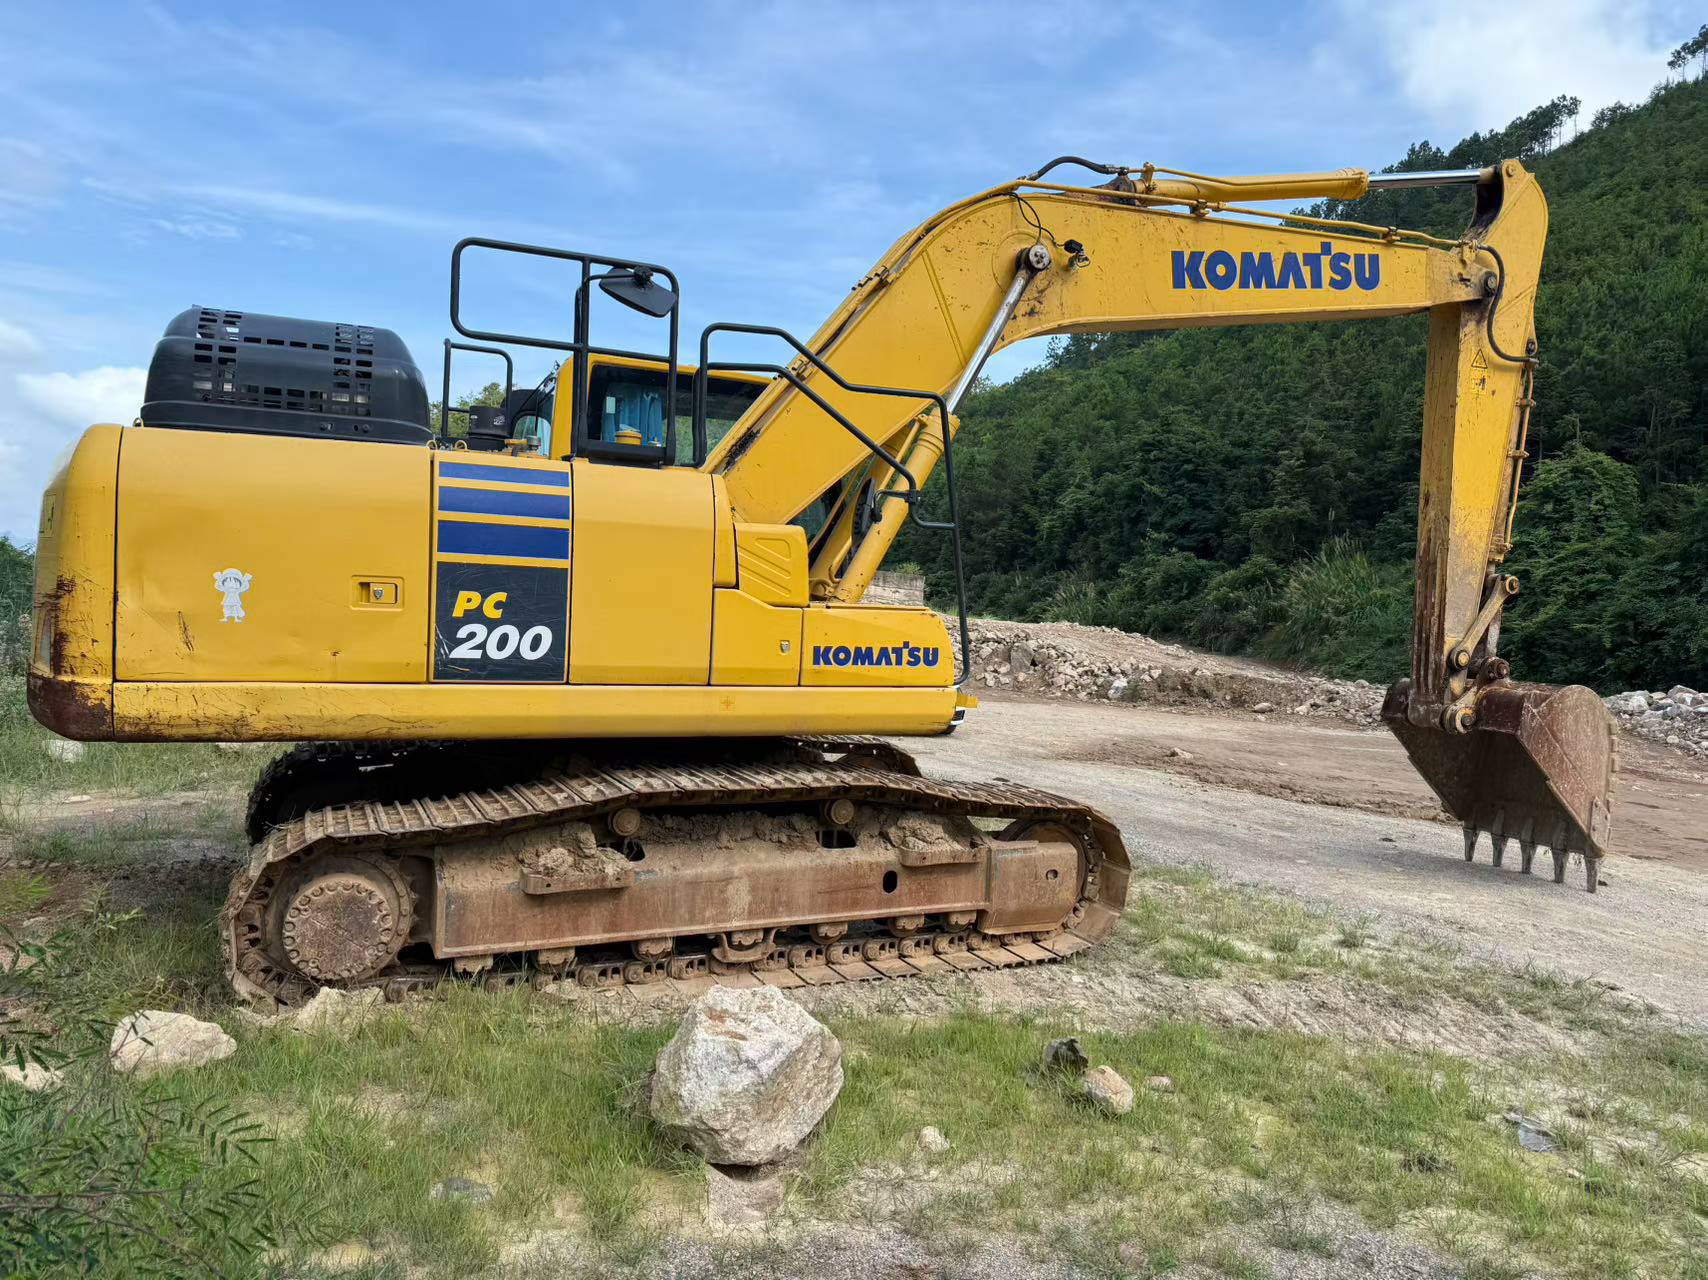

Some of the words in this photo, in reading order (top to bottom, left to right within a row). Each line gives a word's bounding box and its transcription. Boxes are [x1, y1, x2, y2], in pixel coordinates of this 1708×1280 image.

[1171, 241, 1380, 291] KOMATSU
[452, 590, 508, 619] PC
[449, 623, 553, 660] 200
[812, 641, 939, 667] KOMATSU
